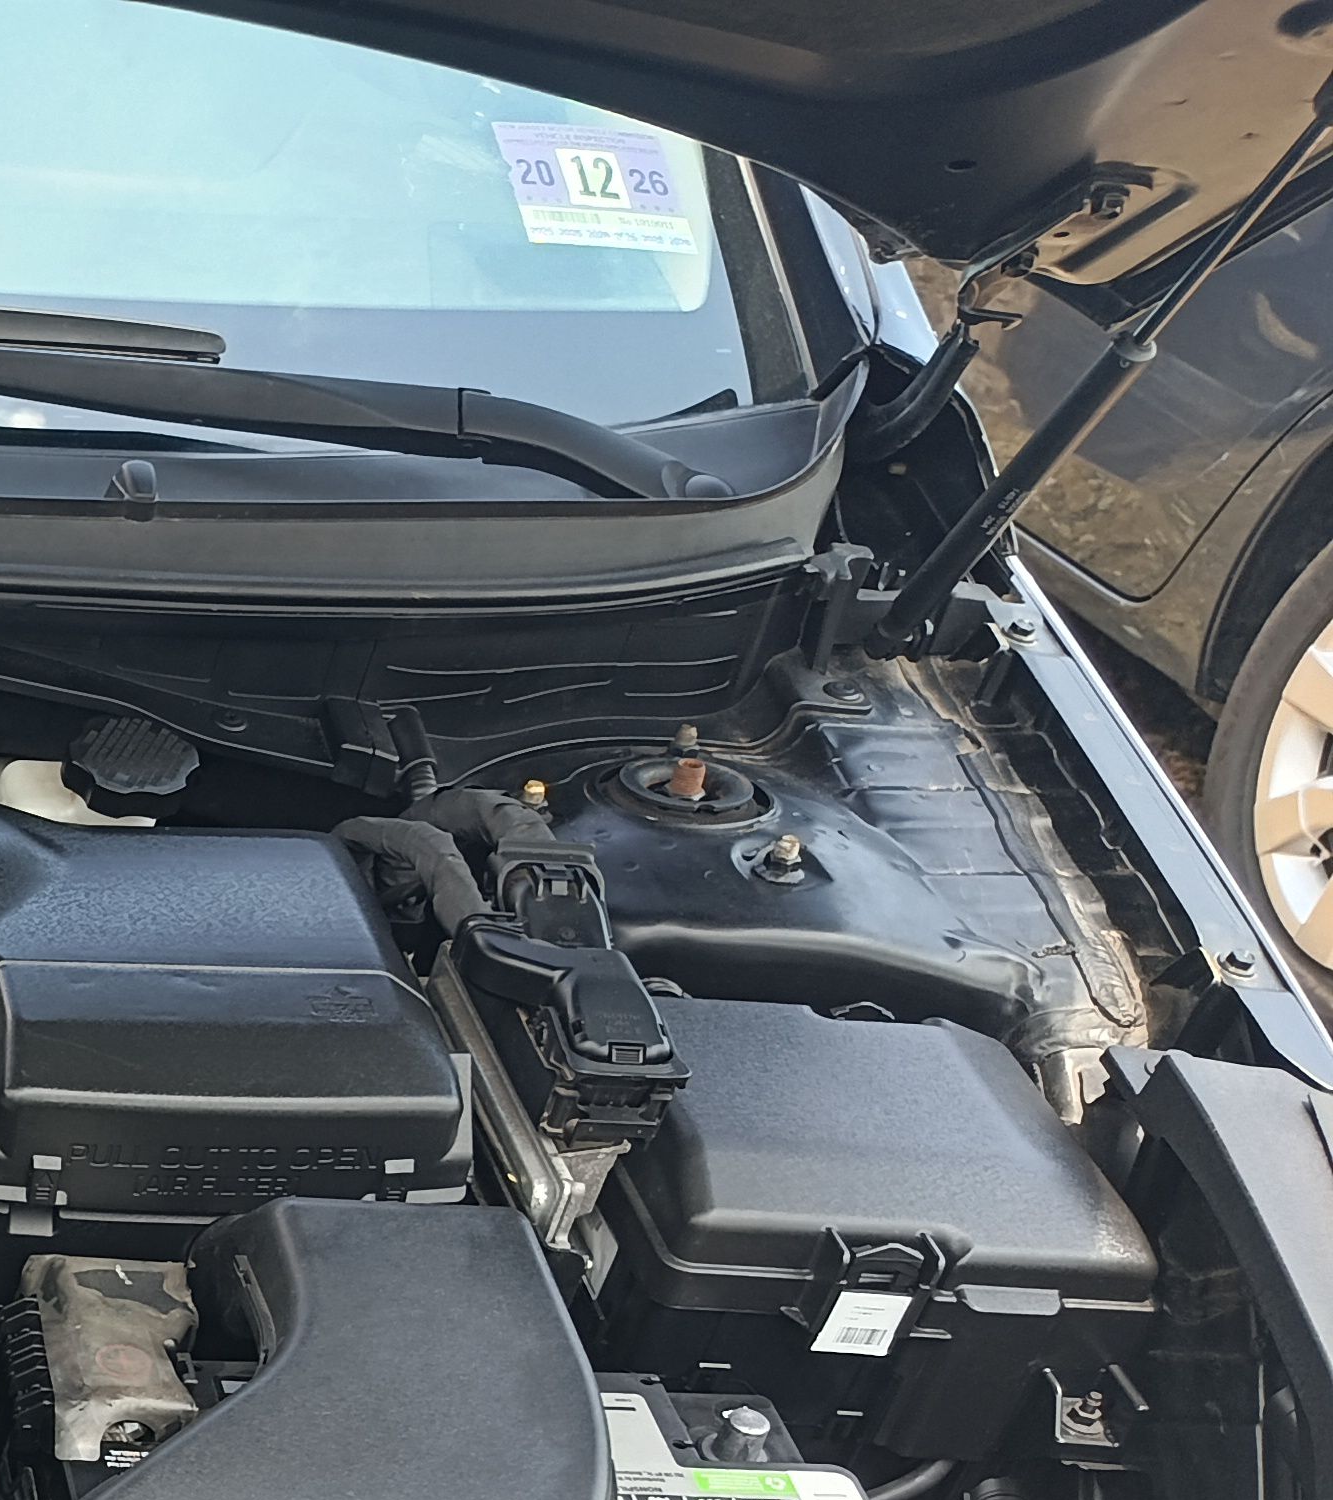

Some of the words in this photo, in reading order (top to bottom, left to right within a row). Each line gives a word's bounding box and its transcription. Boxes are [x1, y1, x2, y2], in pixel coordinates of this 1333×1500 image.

[516, 158, 555, 187] 20
[570, 155, 620, 200] 12
[628, 168, 669, 197] 26
[68, 1144, 150, 1169] PULL
[158, 1147, 225, 1171] OUT
[288, 1148, 378, 1172] OPEN
